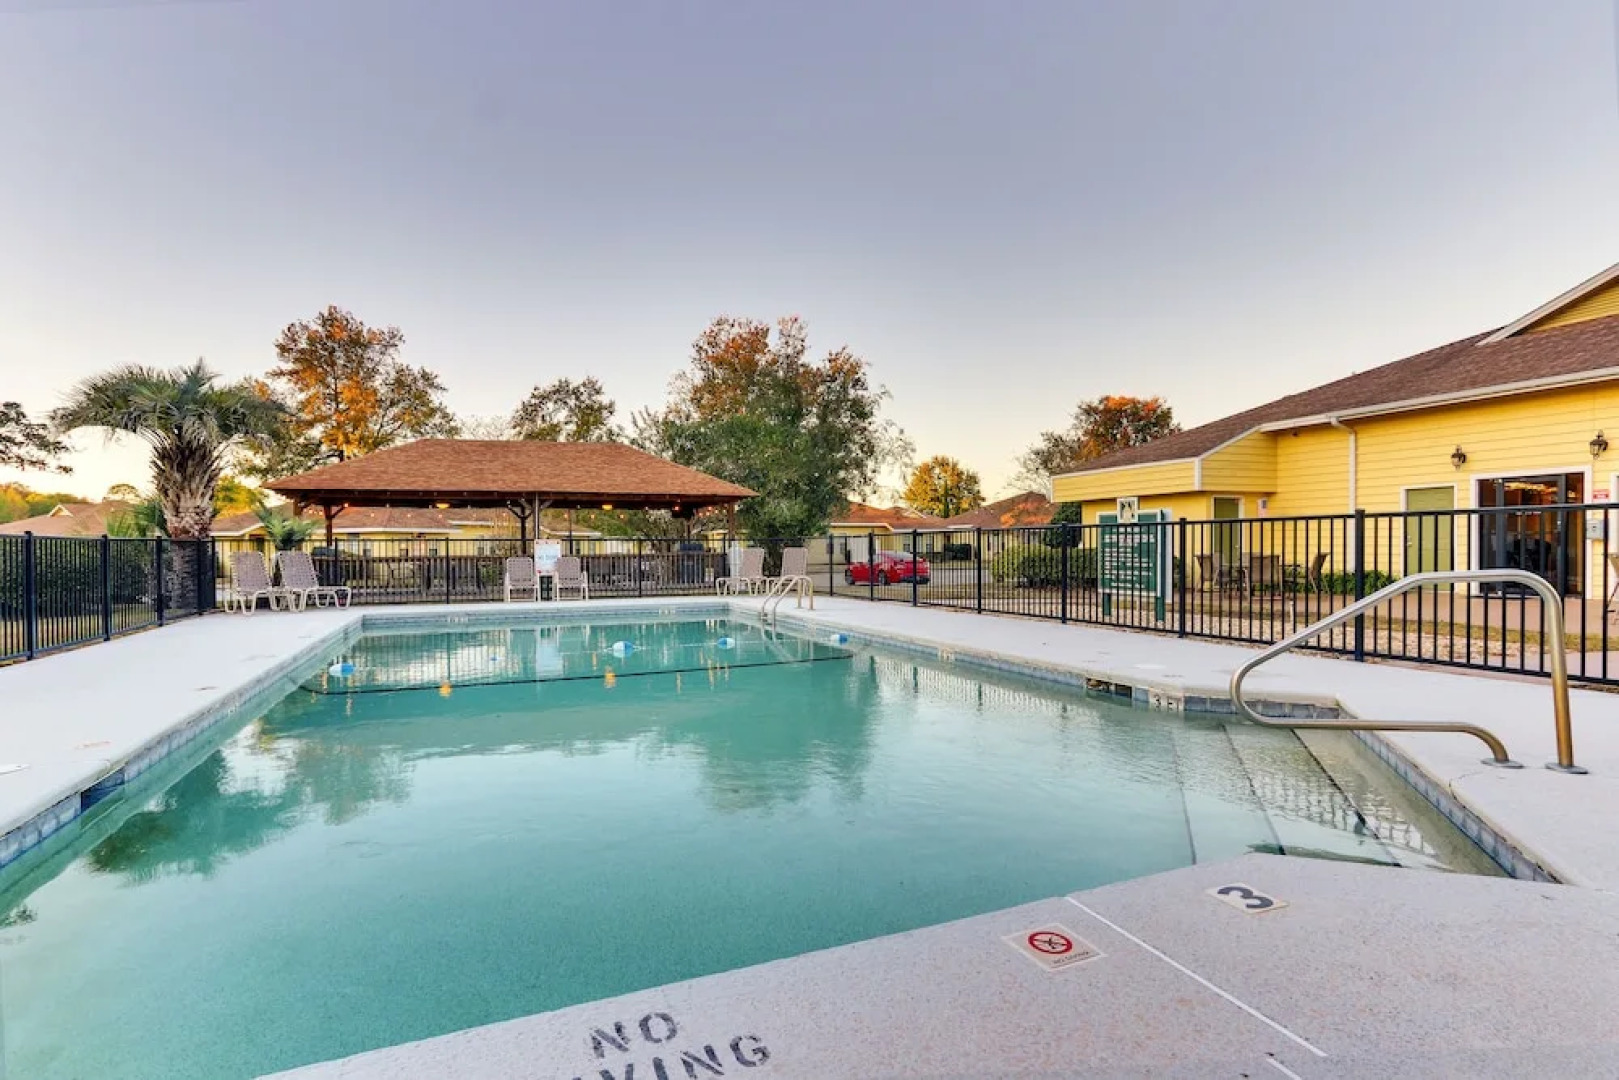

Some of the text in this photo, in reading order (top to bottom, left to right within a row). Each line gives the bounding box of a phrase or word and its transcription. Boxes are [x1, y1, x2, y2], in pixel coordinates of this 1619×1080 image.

[1217, 886, 1274, 909] 3
[572, 1035, 771, 1080] VING
[589, 1012, 678, 1059] NO
